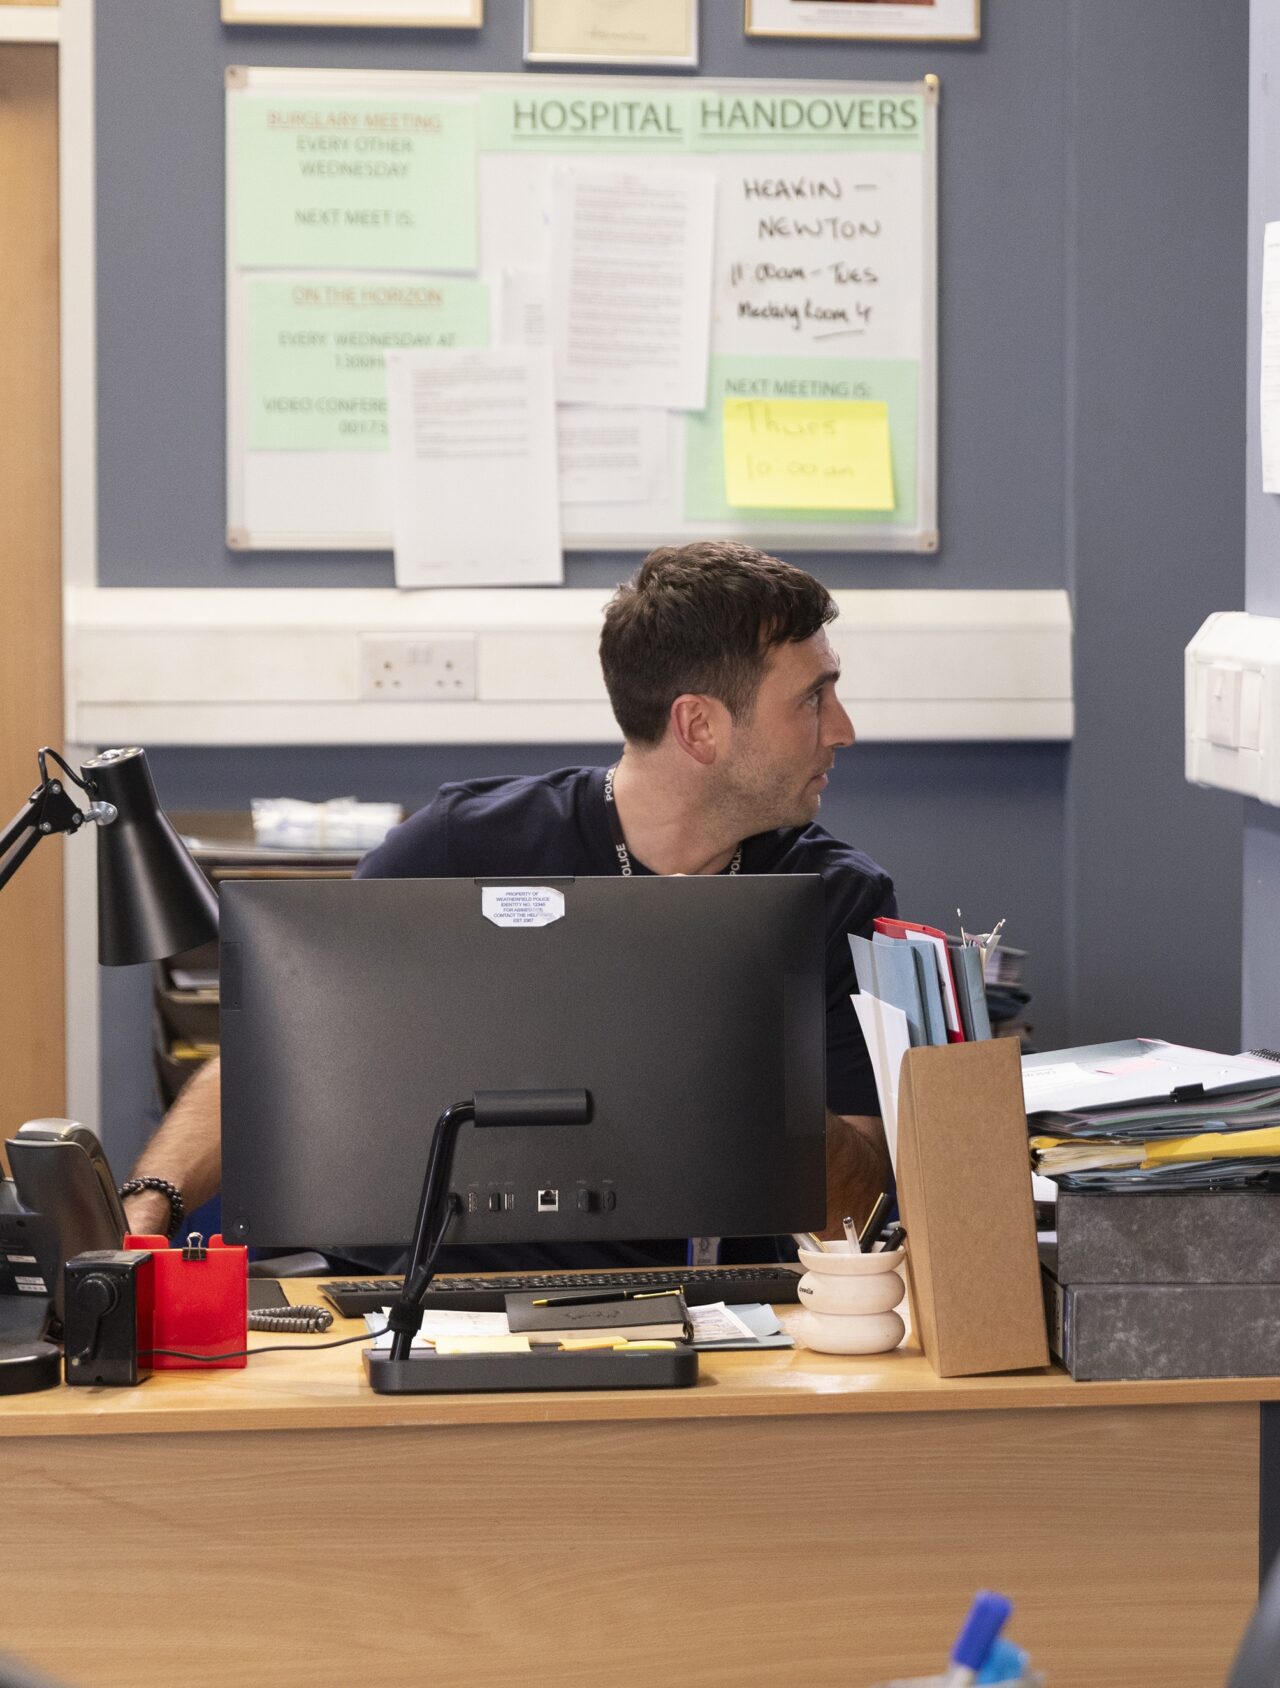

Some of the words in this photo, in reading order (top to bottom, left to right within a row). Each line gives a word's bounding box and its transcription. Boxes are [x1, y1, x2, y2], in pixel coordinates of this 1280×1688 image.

[267, 110, 358, 131] BURGLARY
[362, 112, 442, 132] MEETING
[513, 101, 683, 135] HOSPITAL
[700, 98, 919, 131] HANDOVERS
[296, 136, 349, 154] EVERY
[353, 137, 414, 155] OTHER
[300, 160, 410, 178] WEDNESDAY
[294, 208, 341, 227] NEXT
[344, 209, 391, 227] MEET
[757, 215, 882, 241] NEWTON
[292, 287, 320, 304] ON
[324, 286, 355, 305] THE
[360, 286, 443, 306] HORIZON
[278, 330, 326, 346] EVERY
[333, 331, 432, 347] WEDNESDAY
[436, 332, 456, 347] AT
[725, 377, 769, 393] NEXT
[772, 379, 849, 395] MEETING
[262, 396, 314, 413] VIDEO
